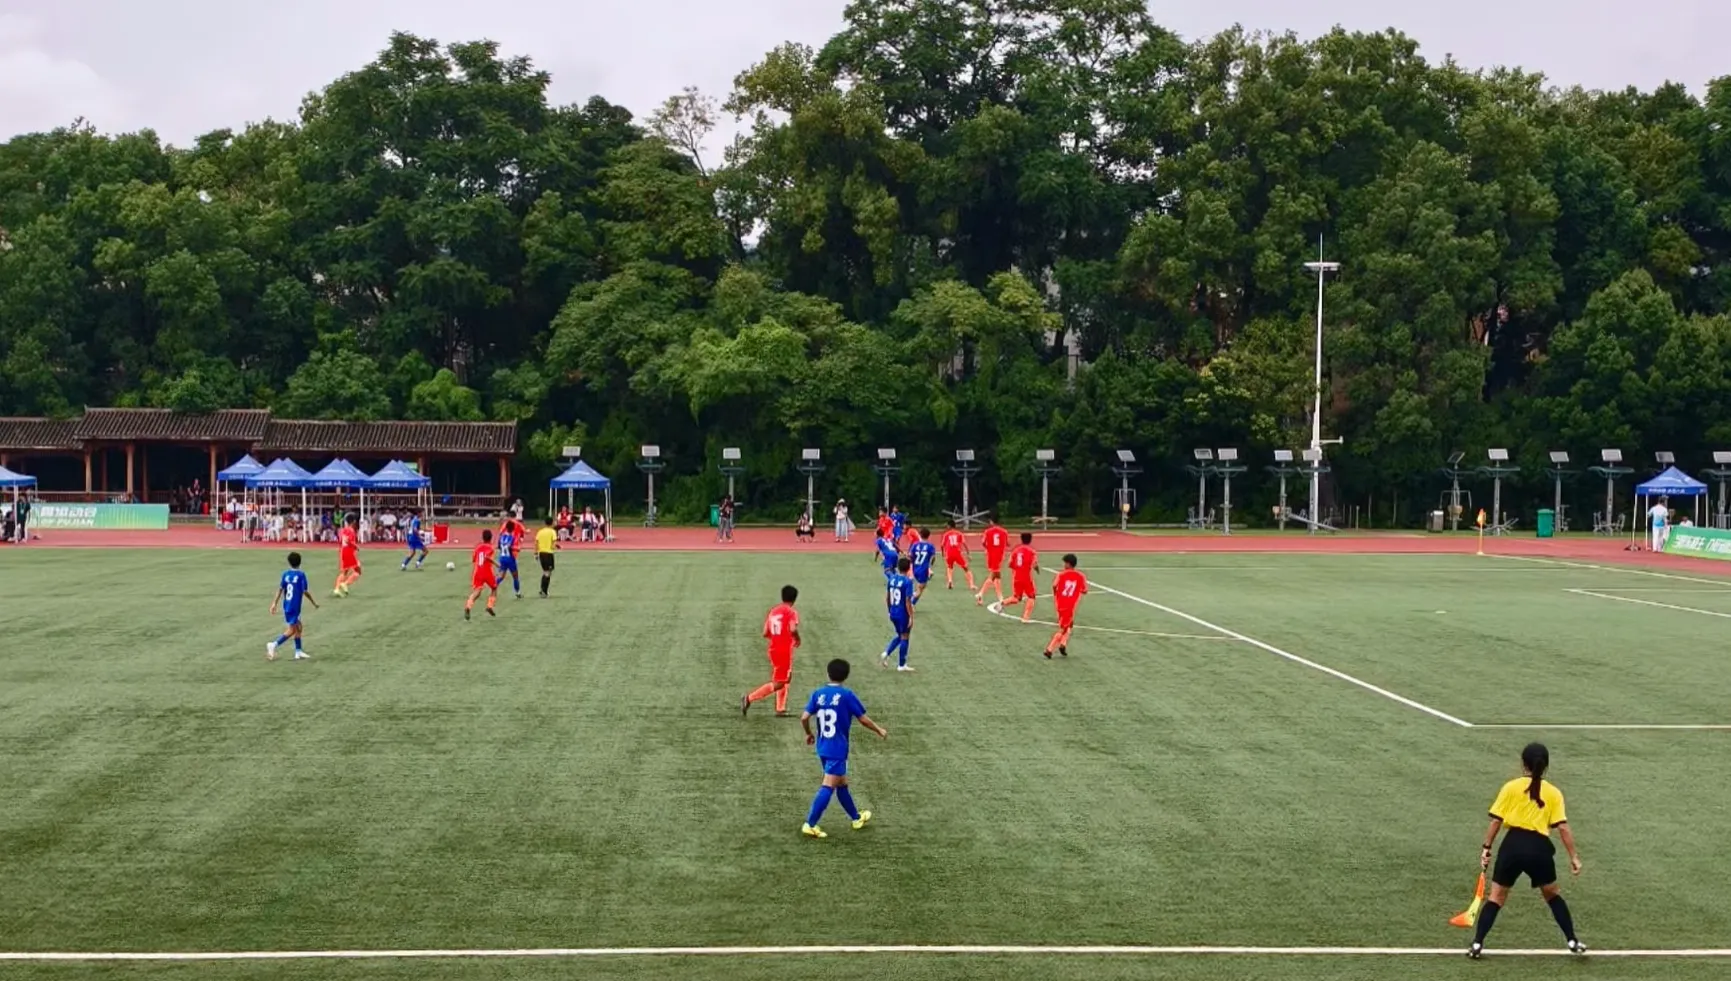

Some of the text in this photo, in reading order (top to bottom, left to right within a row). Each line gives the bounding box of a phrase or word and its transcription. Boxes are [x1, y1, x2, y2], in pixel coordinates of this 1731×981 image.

[915, 551, 928, 565] 27
[285, 583, 294, 601] 8
[889, 587, 902, 606] 19
[816, 708, 838, 739] 13
